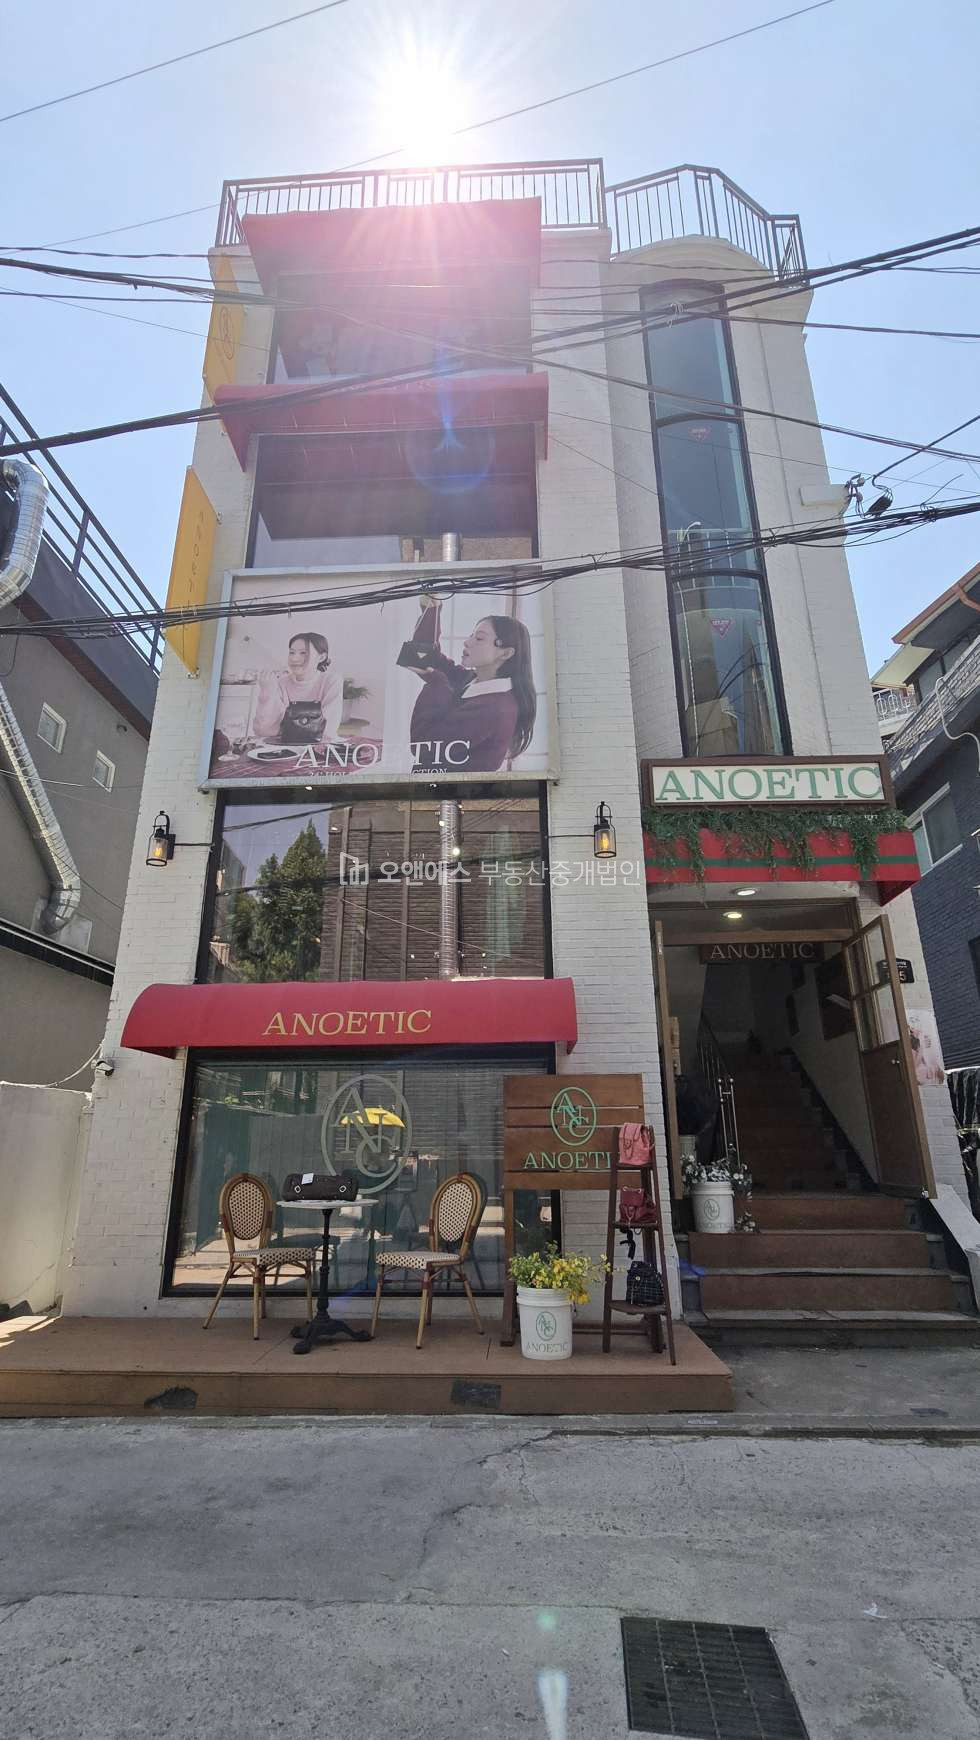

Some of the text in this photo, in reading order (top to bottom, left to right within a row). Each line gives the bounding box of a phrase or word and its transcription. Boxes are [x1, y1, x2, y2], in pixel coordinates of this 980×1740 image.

[293, 739, 471, 769] ANOTIC
[655, 766, 882, 801] ANOETIC
[710, 942, 815, 960] ANOETIC
[261, 1009, 432, 1037] ANOETIC
[523, 1151, 612, 1170] ANOETI
